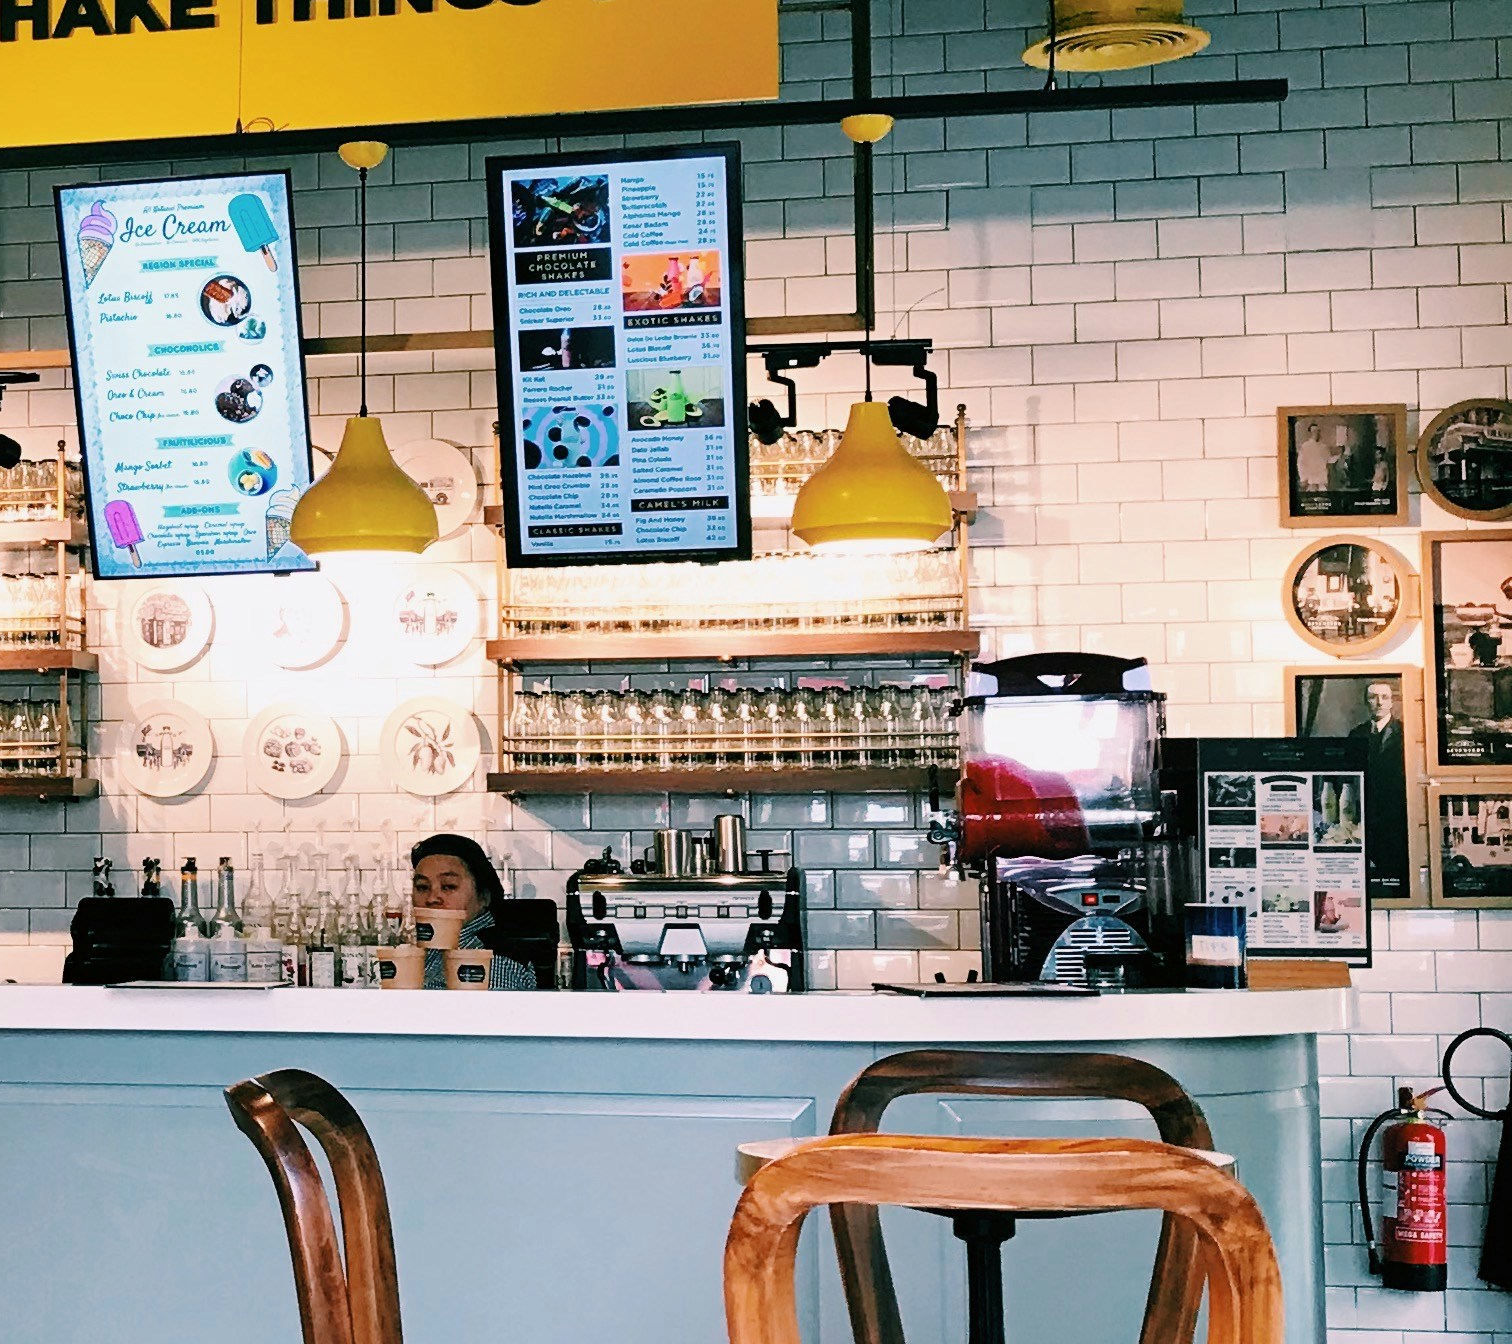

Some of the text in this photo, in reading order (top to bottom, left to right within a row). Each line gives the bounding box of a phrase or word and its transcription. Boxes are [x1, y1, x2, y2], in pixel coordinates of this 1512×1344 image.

[621, 202, 667, 210] Butterscotch
[119, 213, 231, 242] Ice Cream
[537, 252, 587, 261] PREMIUM
[143, 259, 215, 270] REGION SPECIAL
[529, 261, 595, 271] CHOCOLATE
[542, 271, 584, 280] SHAKES
[558, 287, 609, 296] DELECTABLE
[97, 291, 153, 304] Lotus Biscoff
[100, 313, 137, 323] Pistachio
[628, 315, 717, 326] EXOTIC SHAKES
[154, 343, 219, 354] CHOCOHOLICS
[106, 368, 169, 381] Swiss Chocolate
[107, 389, 127, 400] Oreo
[137, 388, 164, 399] Cream
[109, 412, 133, 422] Choco
[136, 410, 155, 421] Chip
[114, 460, 172, 475] Mango Sorbet
[117, 482, 163, 493] Strawberry
[180, 506, 220, 514] ADD-ONS
